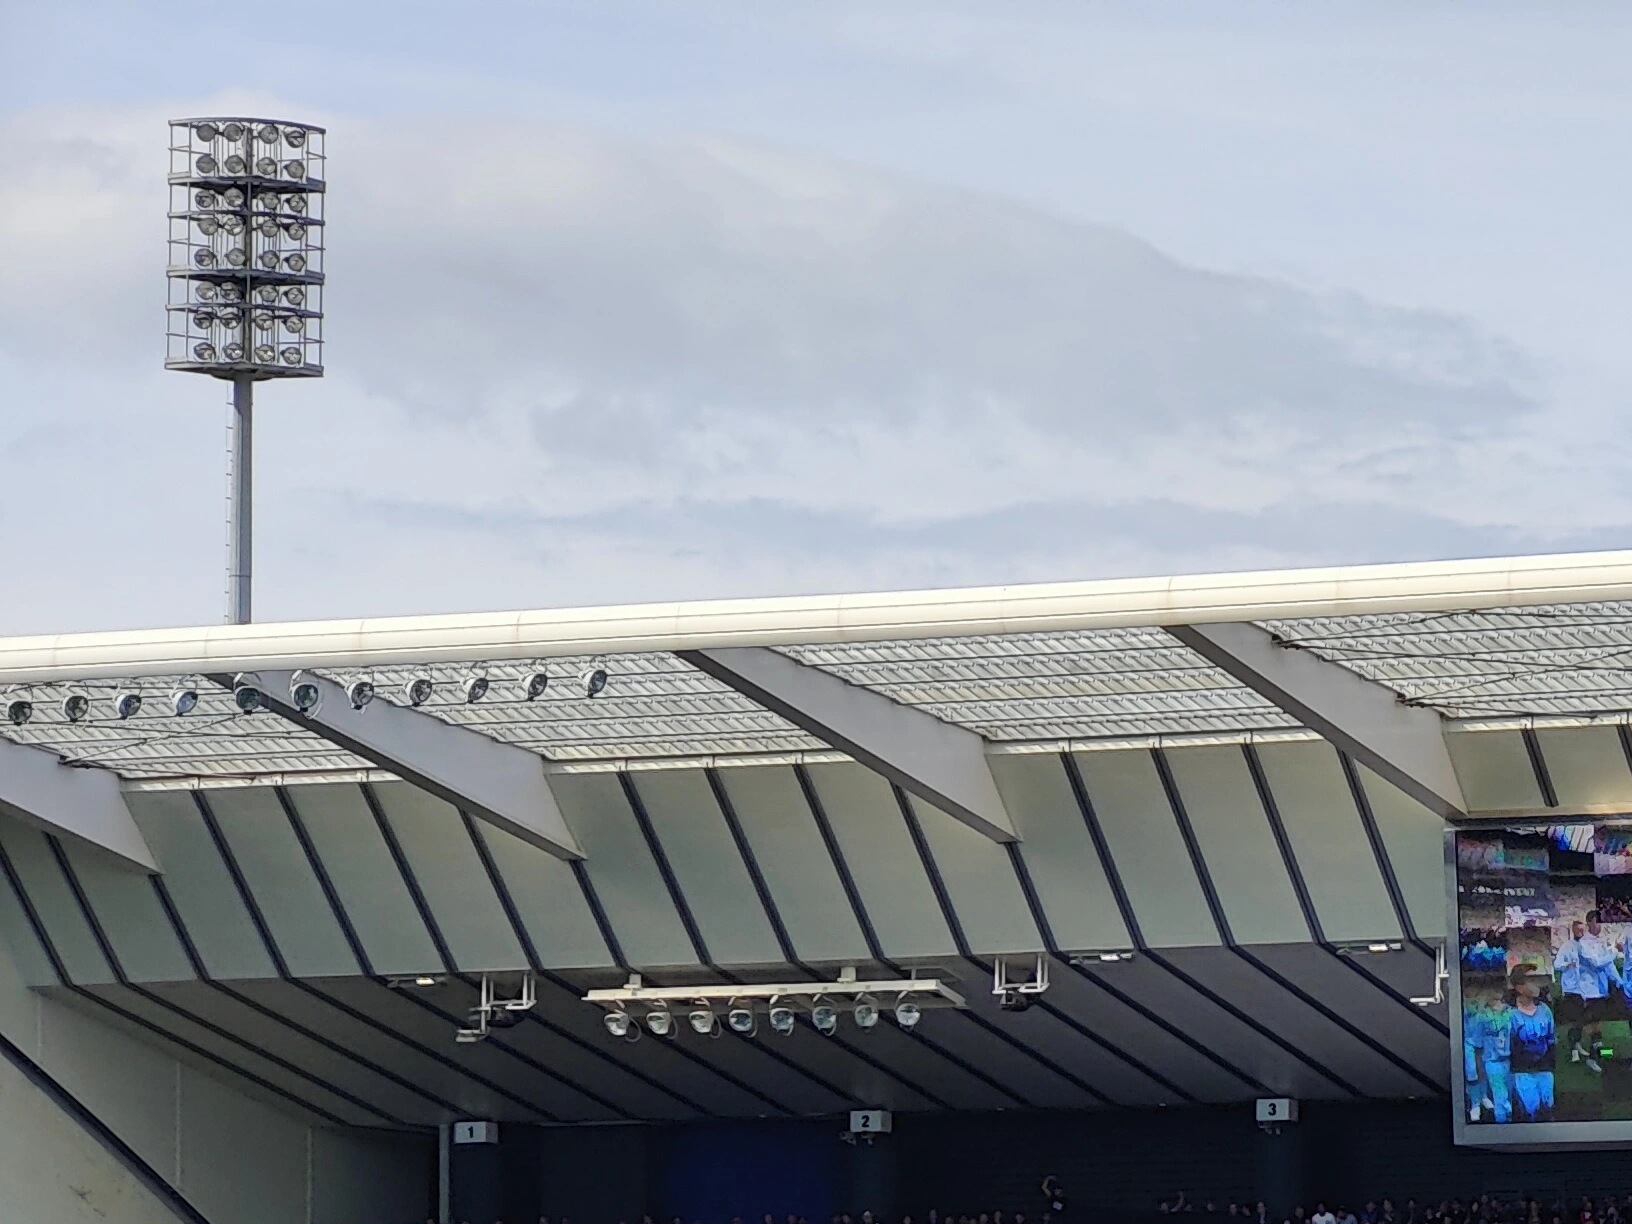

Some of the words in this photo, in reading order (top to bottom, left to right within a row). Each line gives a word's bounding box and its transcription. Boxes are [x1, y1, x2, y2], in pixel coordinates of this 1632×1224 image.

[1267, 1103, 1277, 1117] 3
[861, 1114, 870, 1128] 2
[467, 1125, 474, 1139] 1
